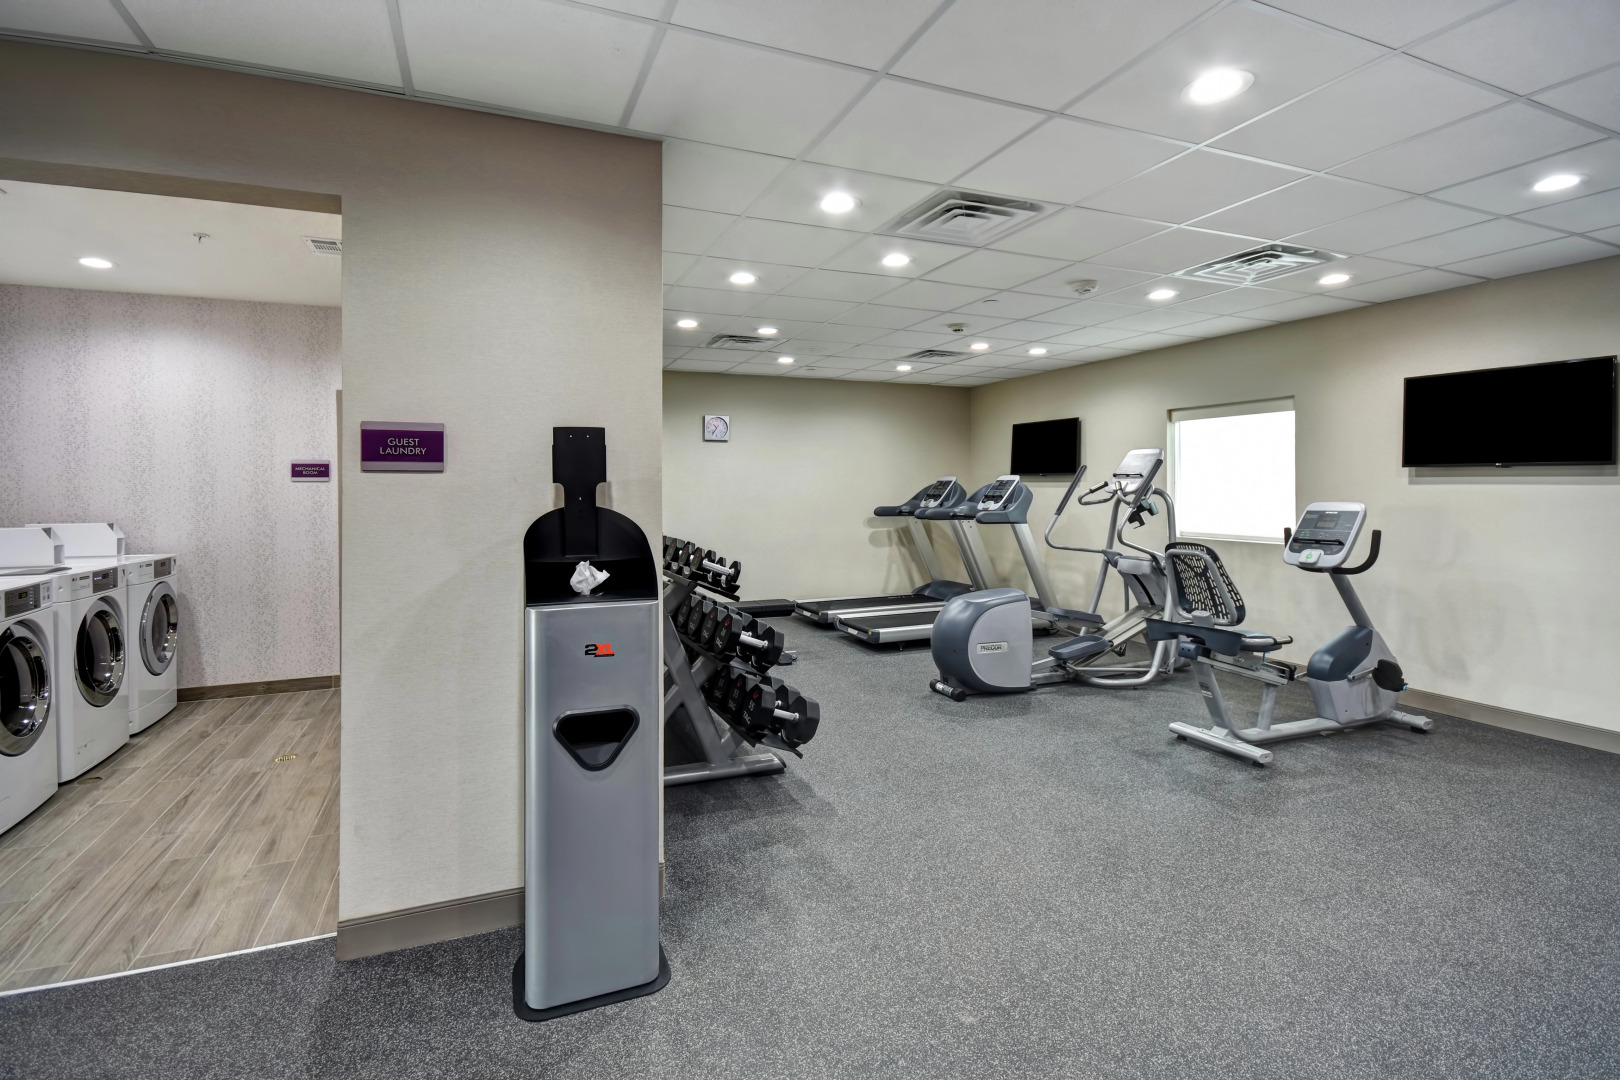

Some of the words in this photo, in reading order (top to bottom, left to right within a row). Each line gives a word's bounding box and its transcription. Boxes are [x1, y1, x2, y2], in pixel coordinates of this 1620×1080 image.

[387, 437, 420, 446] GUEST
[379, 446, 427, 455] LAUNDRY
[584, 642, 616, 656] 2XL
